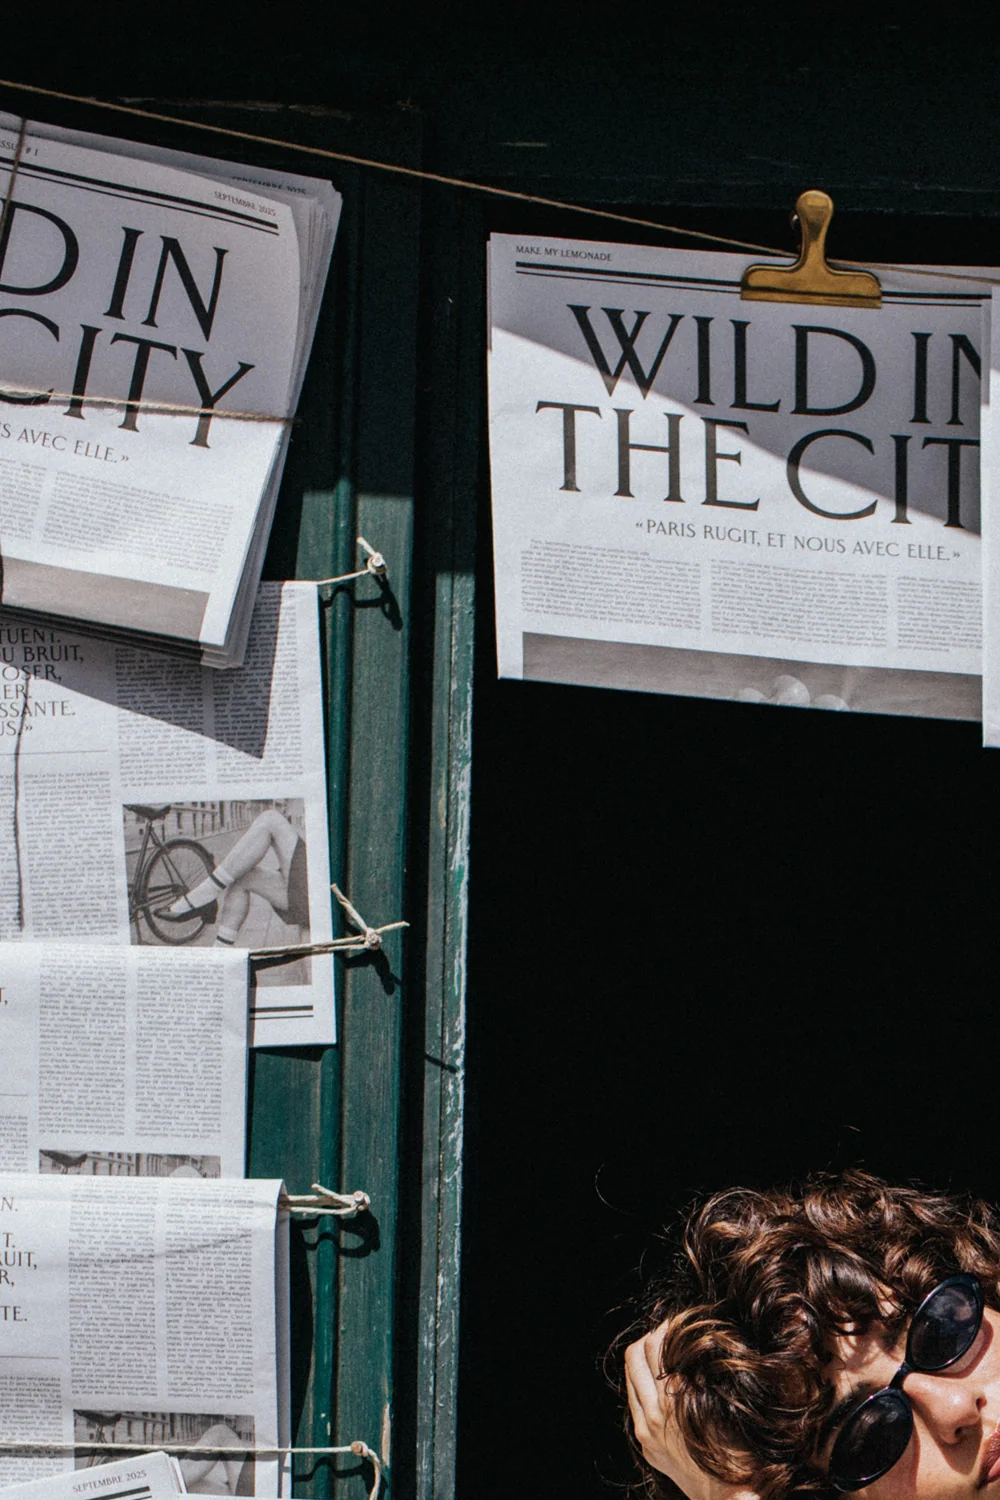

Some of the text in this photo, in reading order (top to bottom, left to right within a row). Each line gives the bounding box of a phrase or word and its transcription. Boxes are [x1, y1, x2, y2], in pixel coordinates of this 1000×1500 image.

[214, 191, 256, 210] SEPTEMBRE
[515, 245, 613, 261] MAKE MY LEMONADE
[102, 226, 229, 342] IN
[567, 304, 877, 417] WILD
[18, 429, 67, 451] AVEC
[74, 439, 130, 463] ELLE.»
[536, 400, 981, 529] THE CIT
[635, 519, 961, 562] «PARIS RUGIT, ET NOUS AVEC ELLE.»
[23, 644, 84, 664] BRUIT,
[72, 1469, 147, 1493] SEPTEMBRE 2025
